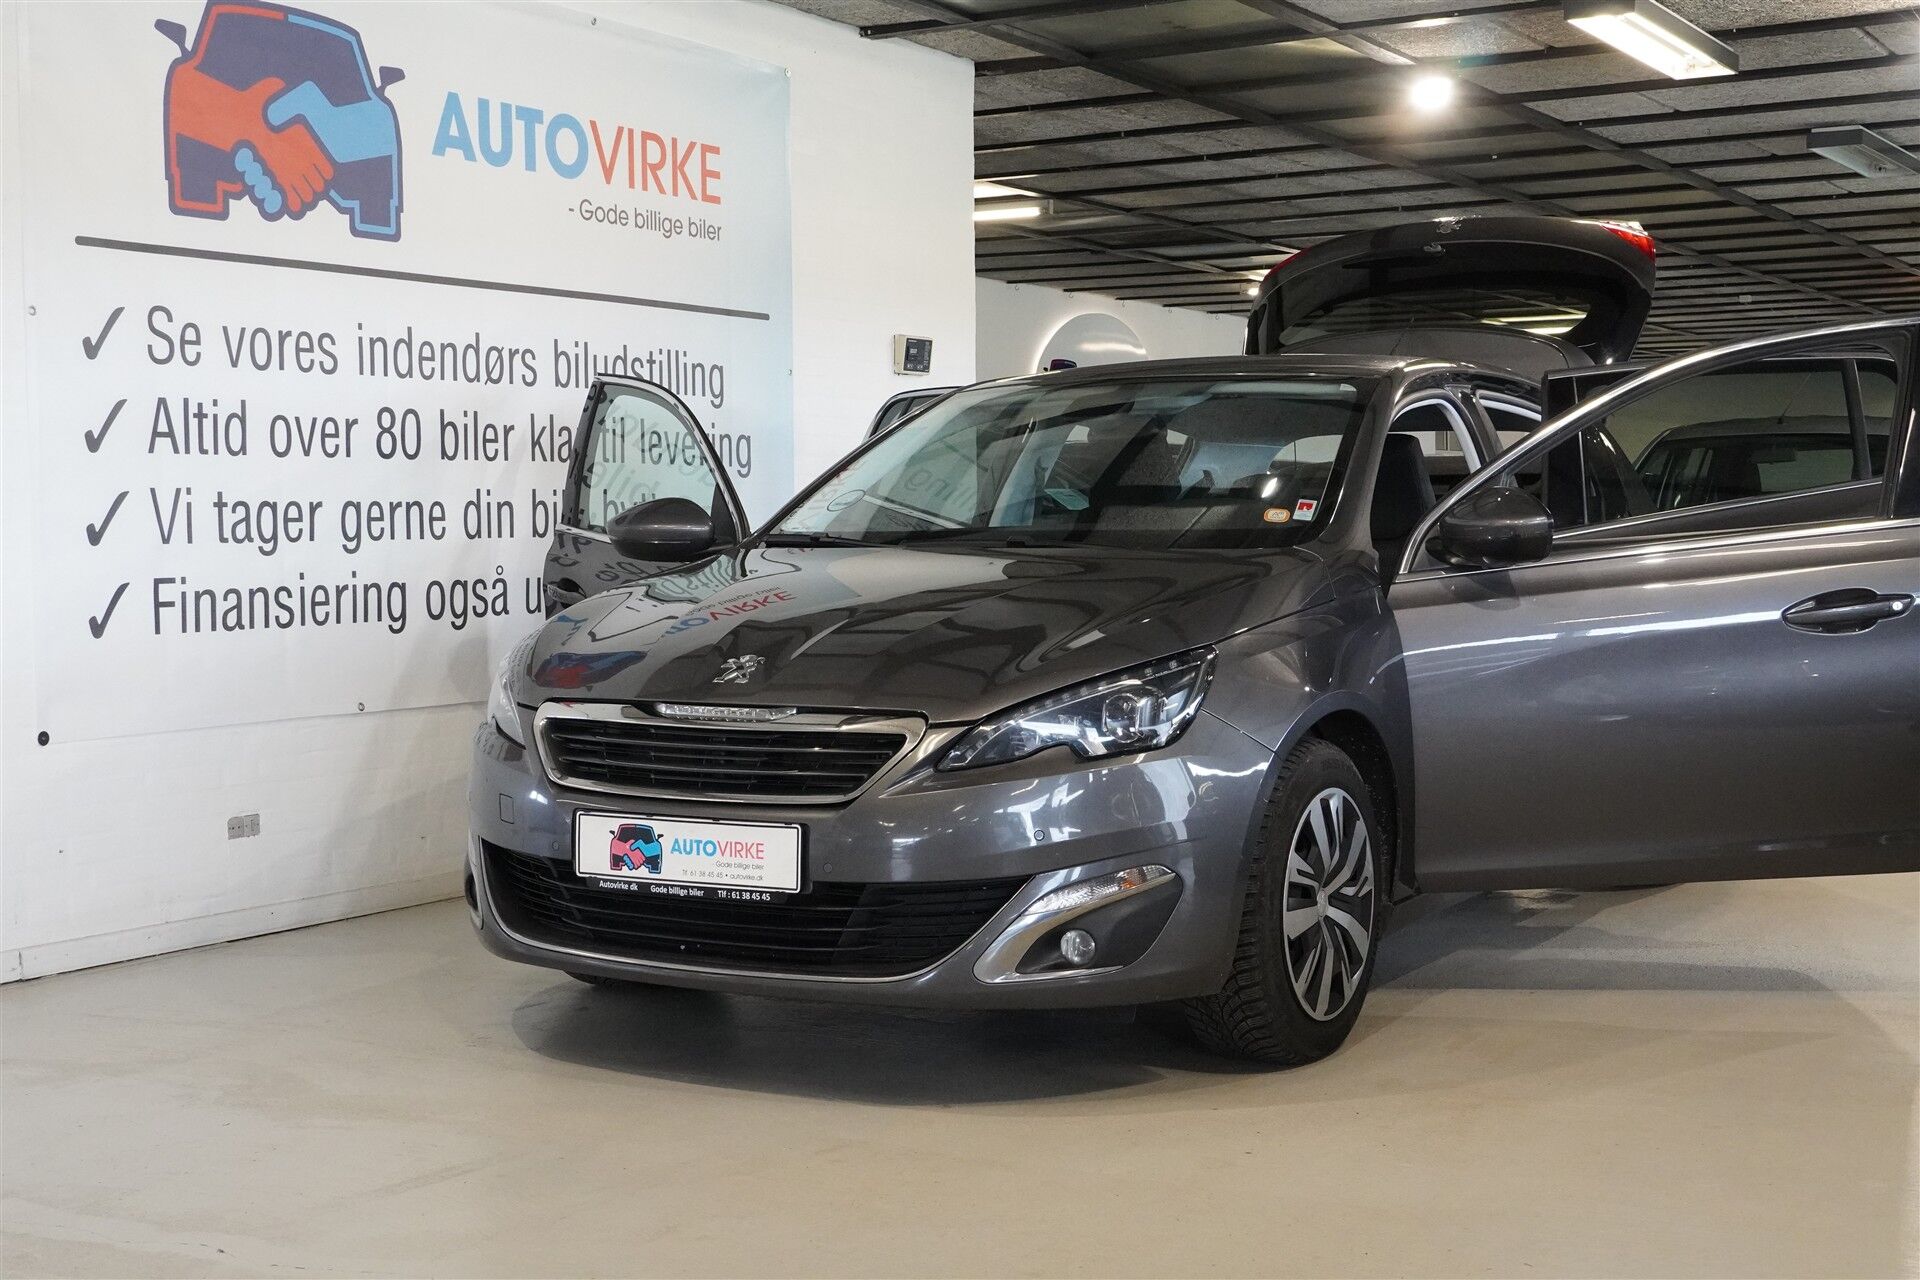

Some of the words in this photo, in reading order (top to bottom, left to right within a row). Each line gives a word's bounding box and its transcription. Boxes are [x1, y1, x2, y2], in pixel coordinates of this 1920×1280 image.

[431, 91, 721, 205] AUTOVIRKE
[579, 199, 629, 227] Gode
[634, 207, 683, 239] billige
[688, 217, 722, 241] biler
[147, 305, 202, 366] Se
[222, 325, 339, 375] vores
[357, 323, 537, 387] indendørs
[148, 397, 248, 457] Altid
[269, 414, 359, 459] over
[376, 407, 422, 460] 80
[440, 409, 515, 462] biler
[530, 413, 577, 463] kla
[600, 416, 625, 463] til
[149, 487, 193, 544] Vi
[213, 491, 323, 556] tager
[341, 500, 447, 554] gerne
[463, 488, 515, 540] din
[153, 570, 407, 634] Finansiering
[425, 565, 510, 631] også
[670, 838, 765, 860] AUTOVIRKE
[715, 860, 733, 869] Gode
[650, 884, 668, 894] Gode
[668, 886, 688, 897] billige
[688, 888, 705, 897] biler
[731, 891, 740, 899] 61
[741, 891, 751, 900] 38
[751, 892, 761, 901] 45
[761, 893, 771, 901] 45
